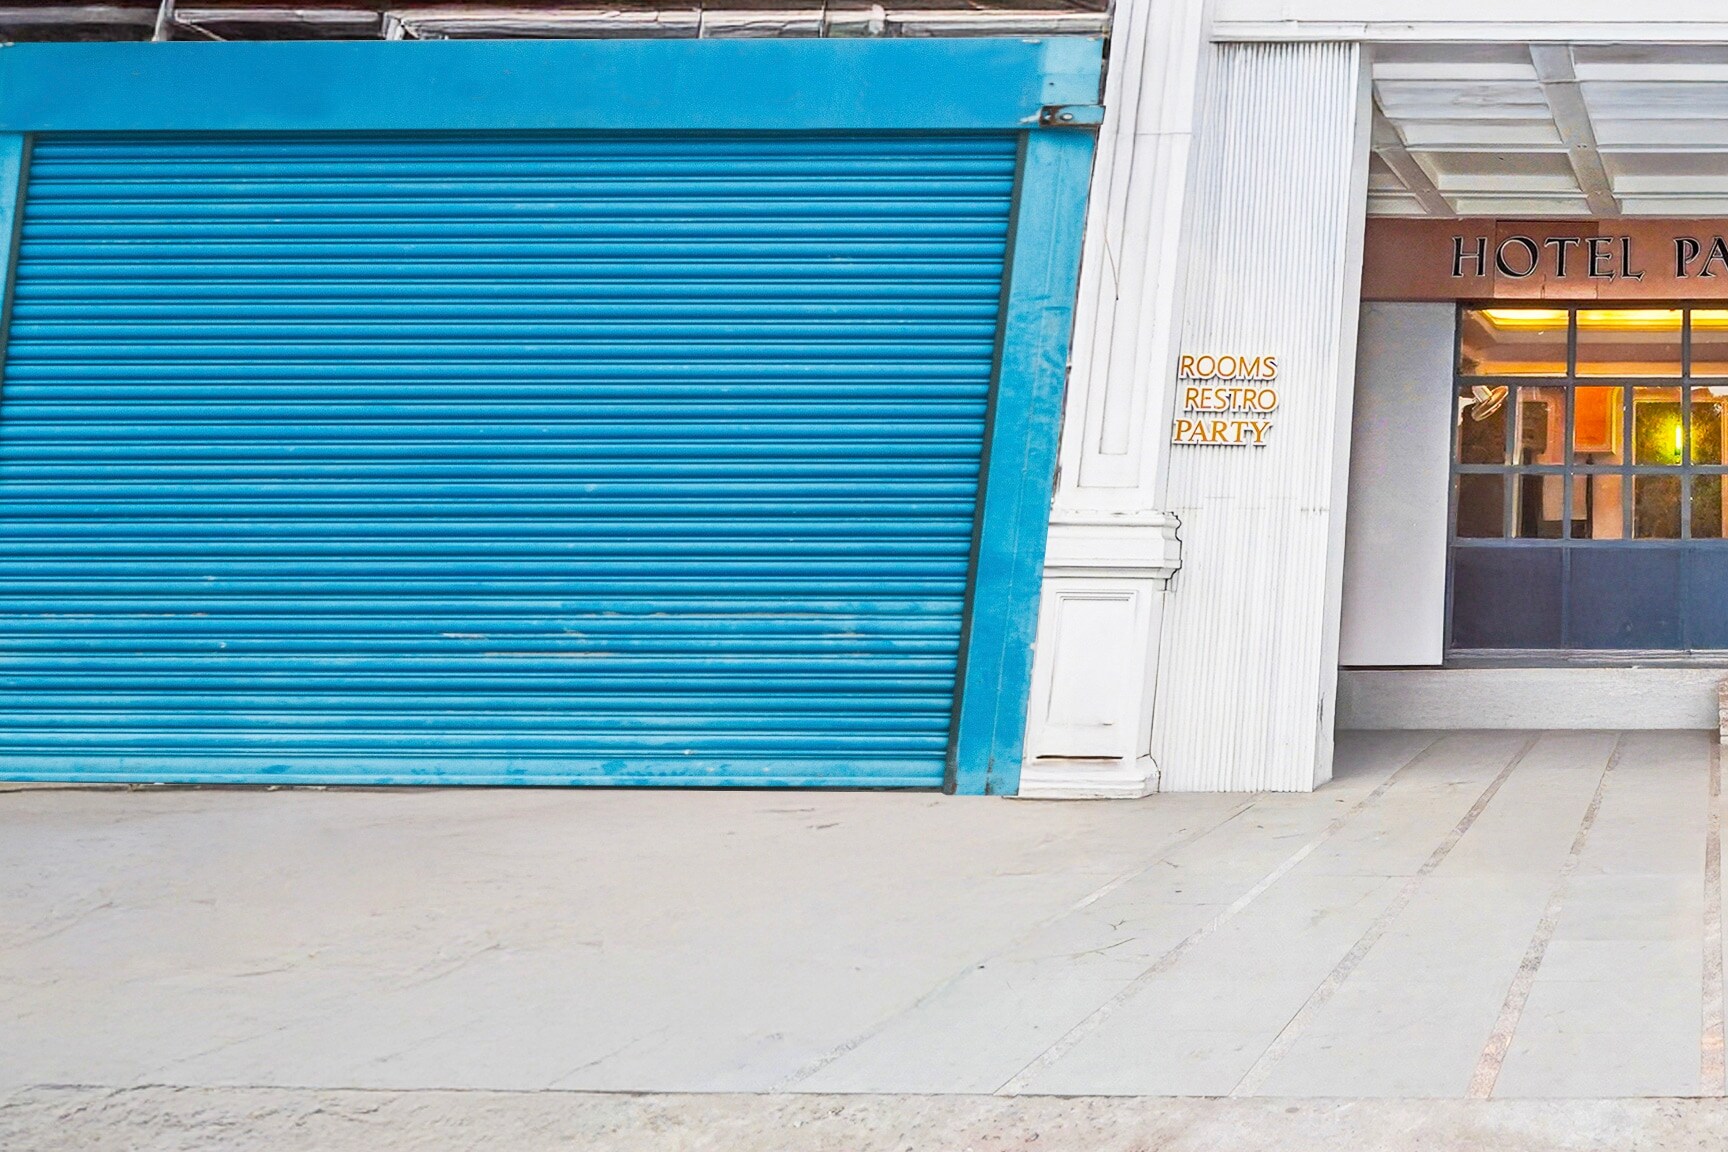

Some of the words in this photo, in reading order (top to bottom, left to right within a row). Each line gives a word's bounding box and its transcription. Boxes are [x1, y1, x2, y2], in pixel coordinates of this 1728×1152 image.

[1451, 235, 1646, 282] HOTEL
[1180, 355, 1277, 379] ROOMS
[1185, 387, 1278, 411] RESTRO
[1174, 419, 1271, 444] PARTY
